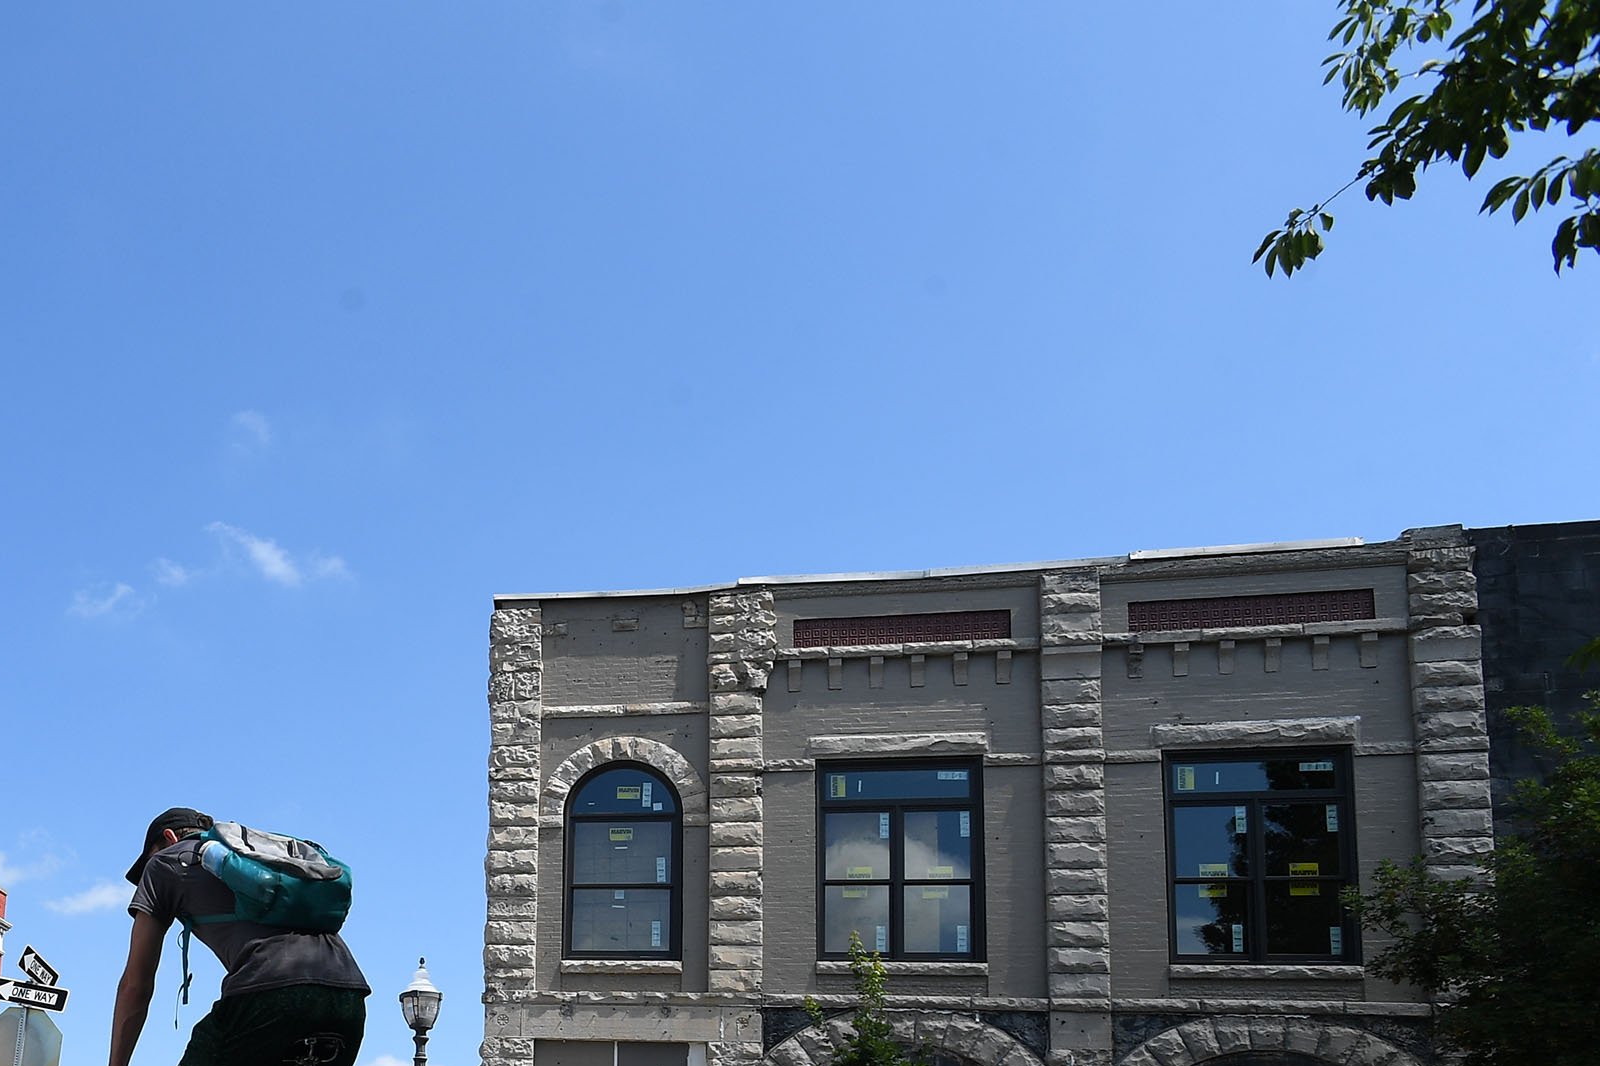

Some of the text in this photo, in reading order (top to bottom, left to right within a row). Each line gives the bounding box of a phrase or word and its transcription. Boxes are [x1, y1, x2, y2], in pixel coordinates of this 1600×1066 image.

[30, 960, 52, 984] ONE WAY
[11, 987, 55, 1003] ONE WAY
